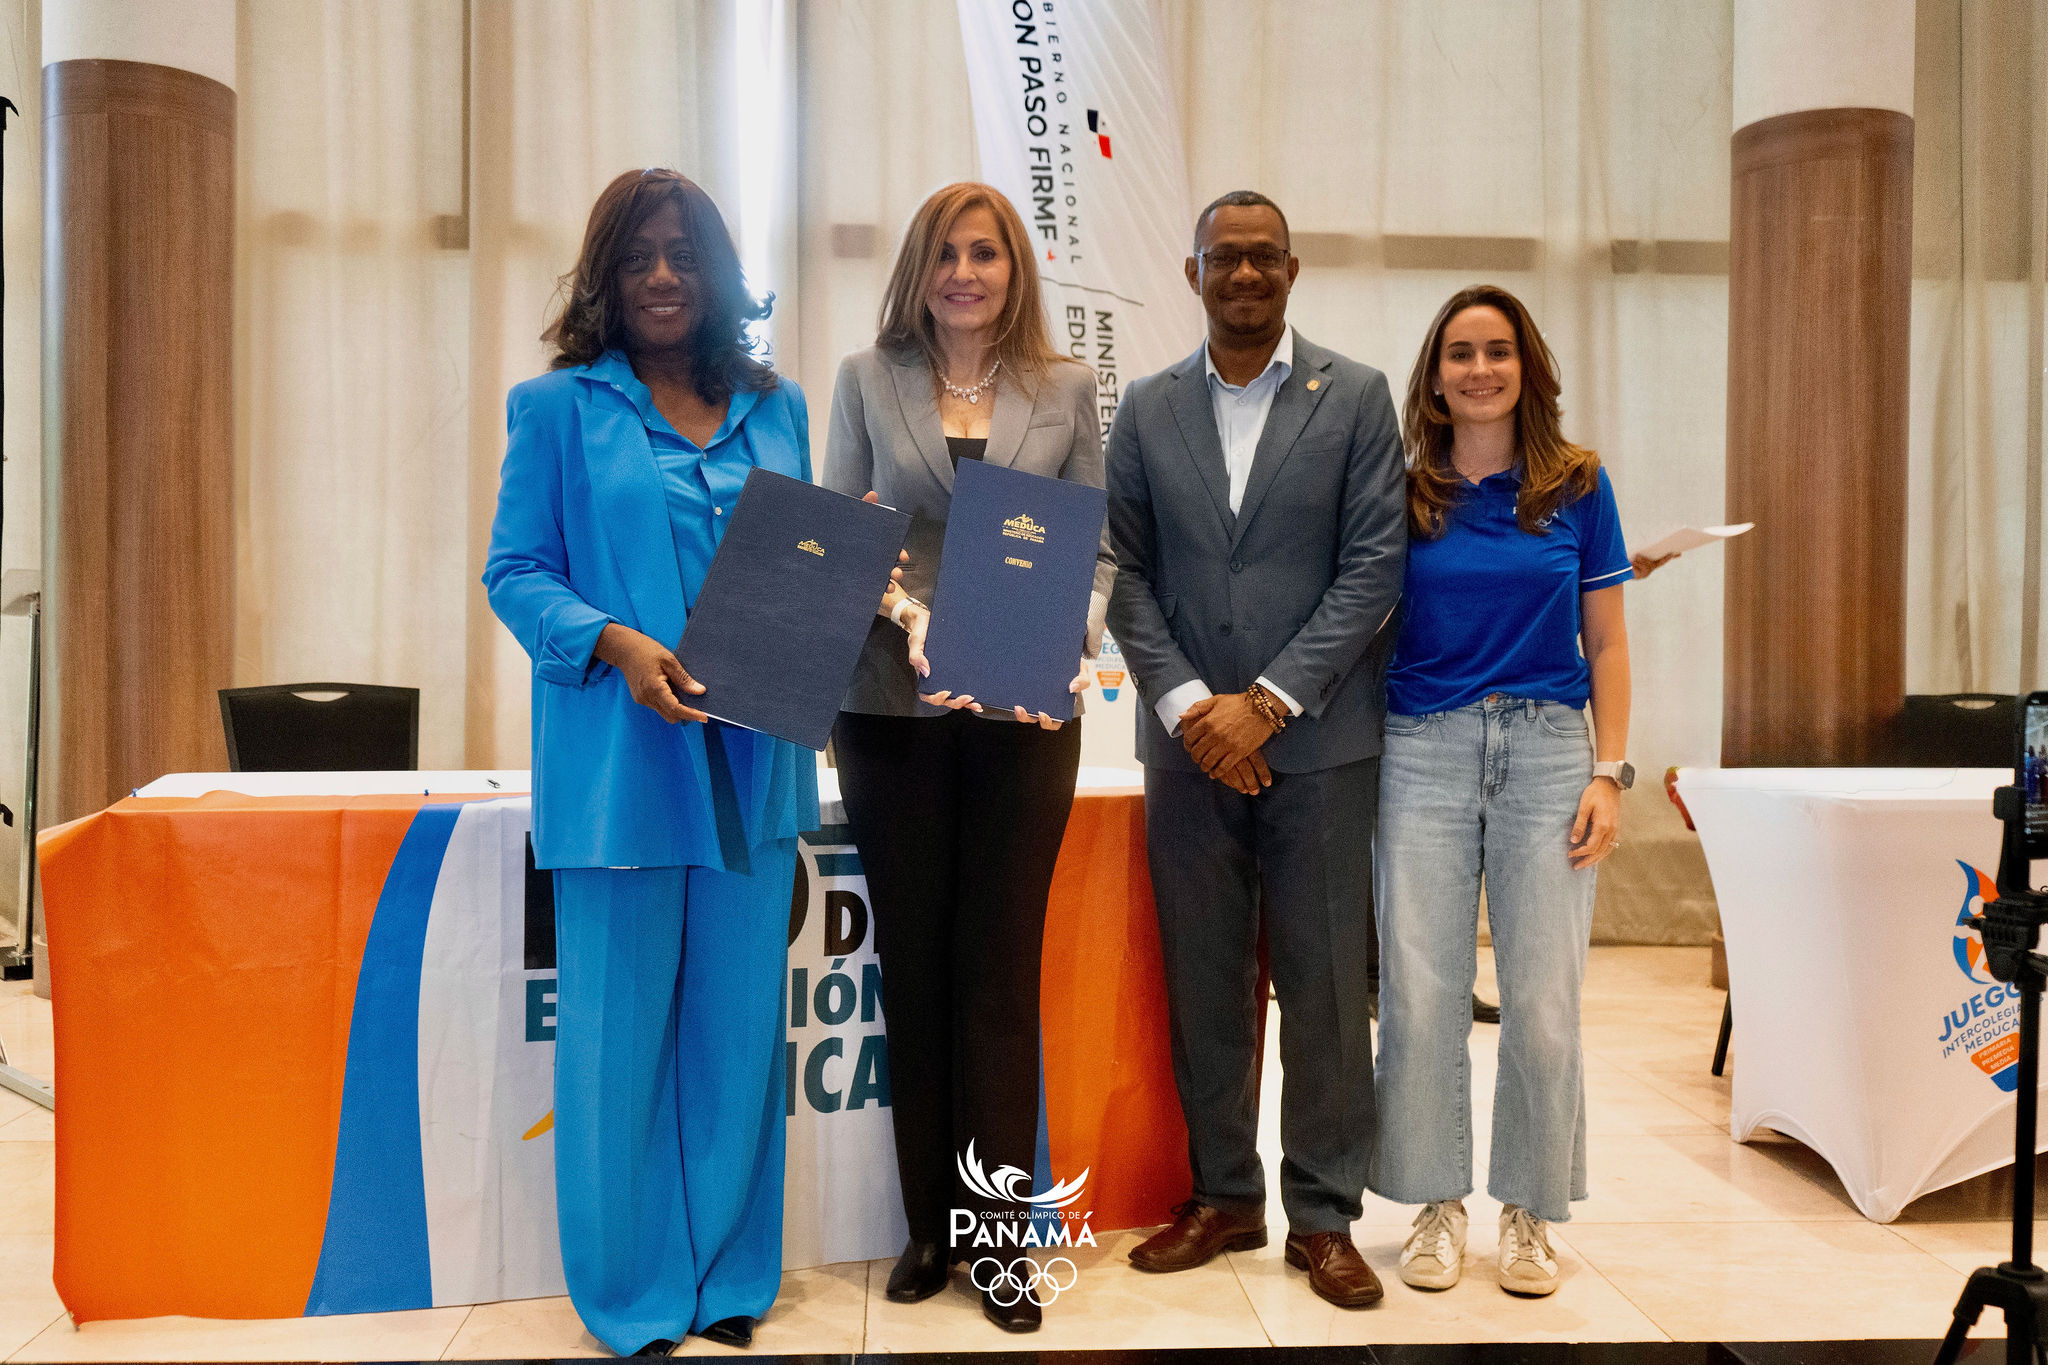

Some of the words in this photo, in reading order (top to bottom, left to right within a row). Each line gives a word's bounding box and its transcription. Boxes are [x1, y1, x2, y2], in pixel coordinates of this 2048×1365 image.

[1012, 0, 1039, 46] ON
[1019, 56, 1047, 137] PASO
[1043, 2, 1067, 104] BIERNO
[1058, 124, 1082, 264] NACIONAL
[1095, 310, 1118, 445] MINISTER
[1003, 518, 1046, 534] MEDUCA
[1938, 981, 2021, 1042] JUEGO
[1965, 1018, 2020, 1054] MEDUCA
